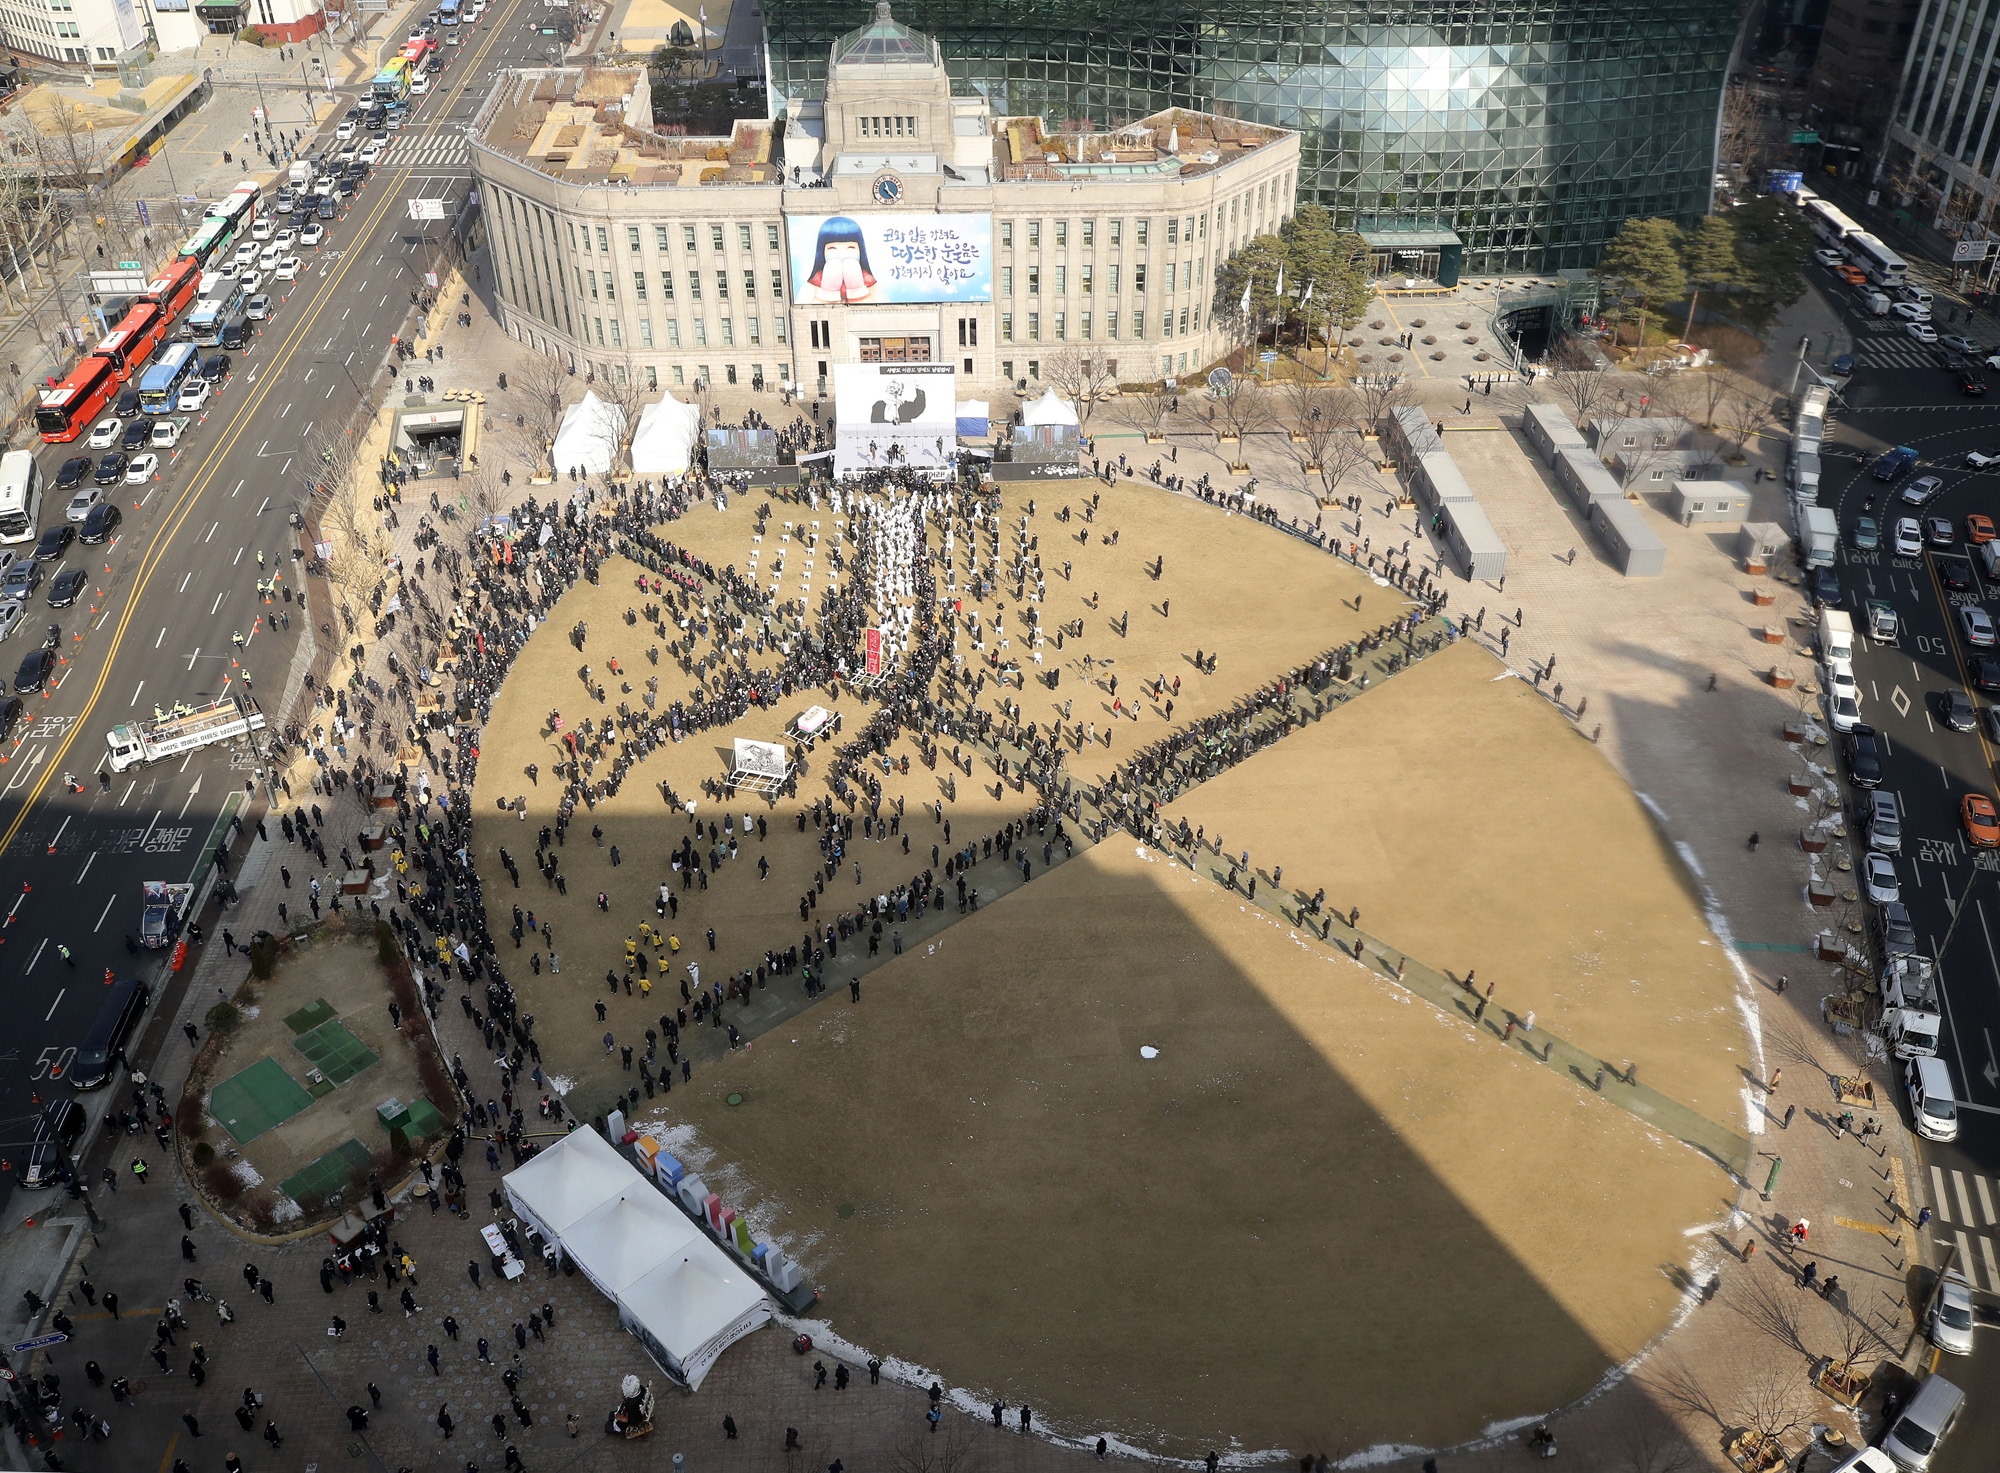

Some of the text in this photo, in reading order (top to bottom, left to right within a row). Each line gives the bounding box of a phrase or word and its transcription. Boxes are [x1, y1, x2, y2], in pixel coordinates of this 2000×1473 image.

[883, 226, 960, 244] 코와 입을 가려도
[890, 242, 980, 264] 따스한 눈웃음은
[889, 265, 975, 285] 가려지지 않아요
[1916, 635, 1947, 656] 50
[160, 724, 245, 752] 사랑도 명예도 이름도 남김없이
[144, 827, 193, 853] 광화문
[30, 1046, 77, 1081] 50
